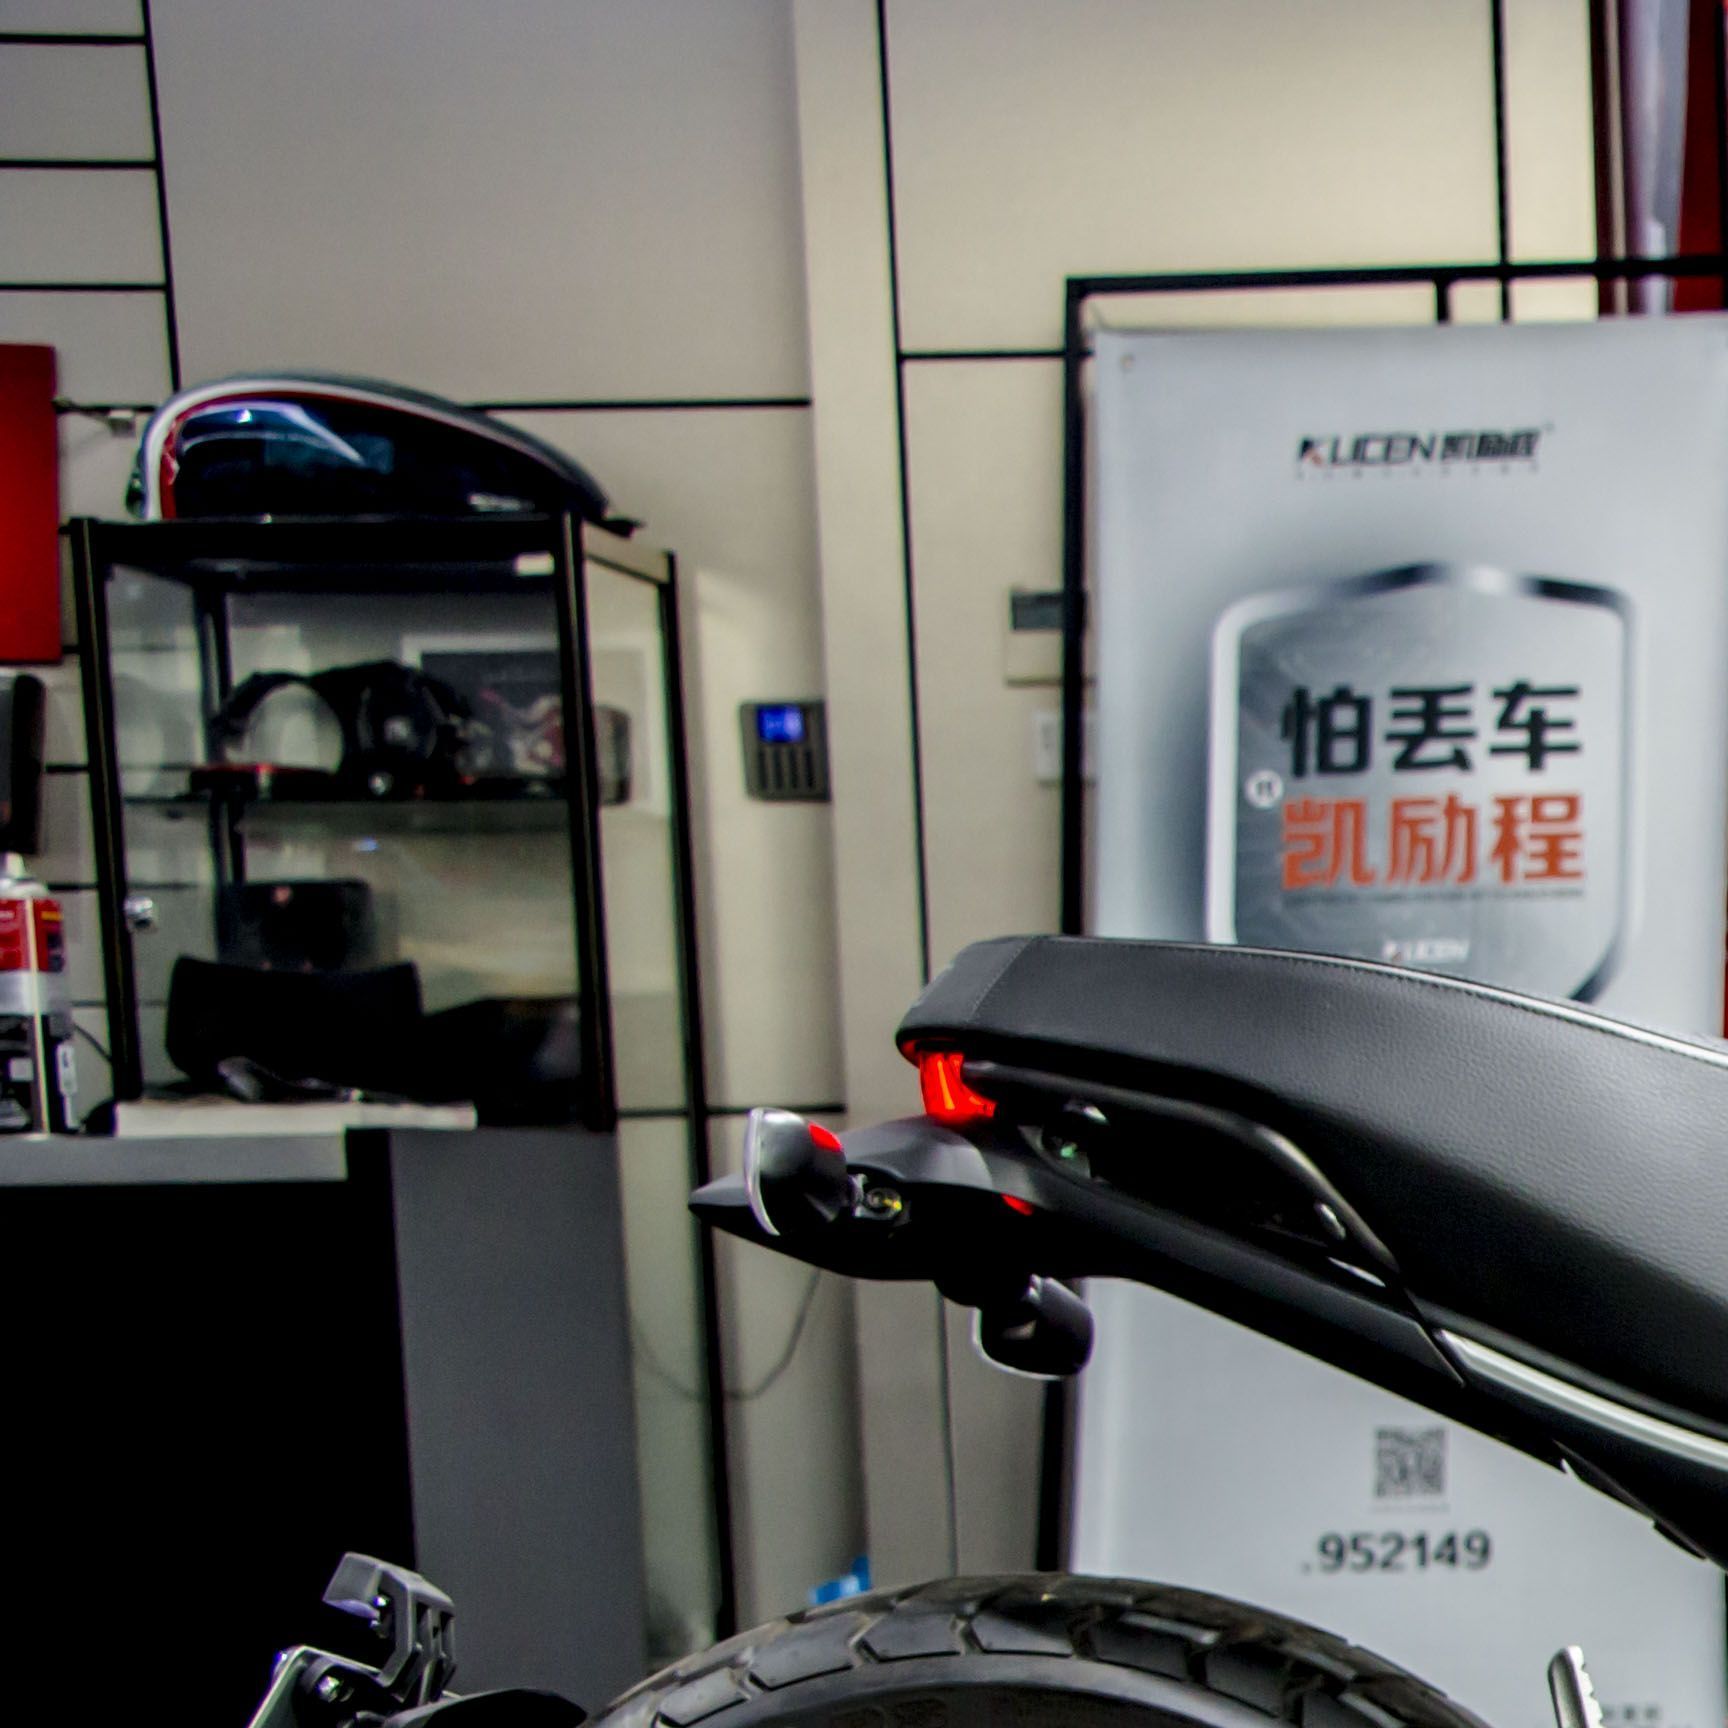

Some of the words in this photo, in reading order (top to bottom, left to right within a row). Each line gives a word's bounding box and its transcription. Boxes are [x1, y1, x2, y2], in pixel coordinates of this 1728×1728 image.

[1281, 680, 1583, 778] 怕丢车
[1280, 793, 1584, 889] 凯励程
